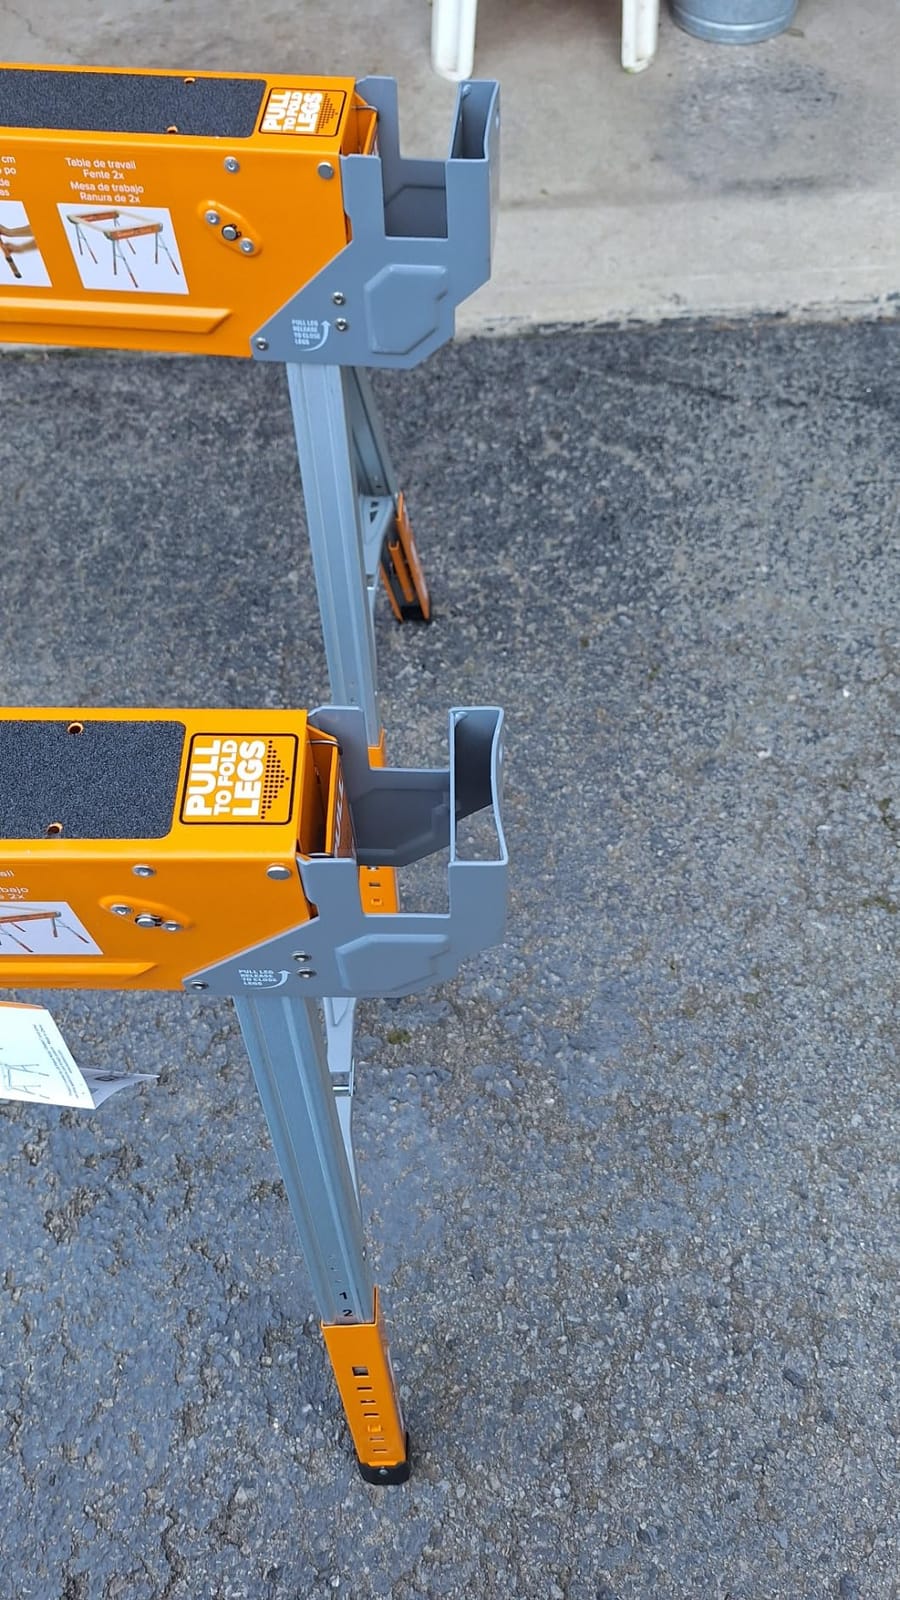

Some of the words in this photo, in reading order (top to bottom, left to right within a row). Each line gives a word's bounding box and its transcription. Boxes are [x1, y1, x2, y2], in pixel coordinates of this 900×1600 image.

[261, 91, 292, 131] PULL
[286, 92, 303, 117] FOLD
[295, 92, 323, 132] LEGS
[282, 117, 298, 131] TO
[1, 156, 16, 164] cm
[64, 157, 91, 168] Table
[93, 159, 106, 168] de
[107, 160, 136, 170] travail
[83, 169, 110, 179] Fente
[111, 170, 124, 180] 2x
[70, 181, 96, 191] Mesa
[97, 183, 110, 192] de
[111, 184, 144, 195] trabajo
[80, 192, 113, 202] Ranura
[114, 194, 127, 202] de
[128, 195, 141, 203] 2x
[217, 740, 238, 787] FOLD
[186, 740, 221, 816] PULL
[232, 740, 266, 816] LEGS
[213, 790, 232, 816] TO
[339, 1291, 347, 1300] 1
[342, 1308, 353, 1317] 2
